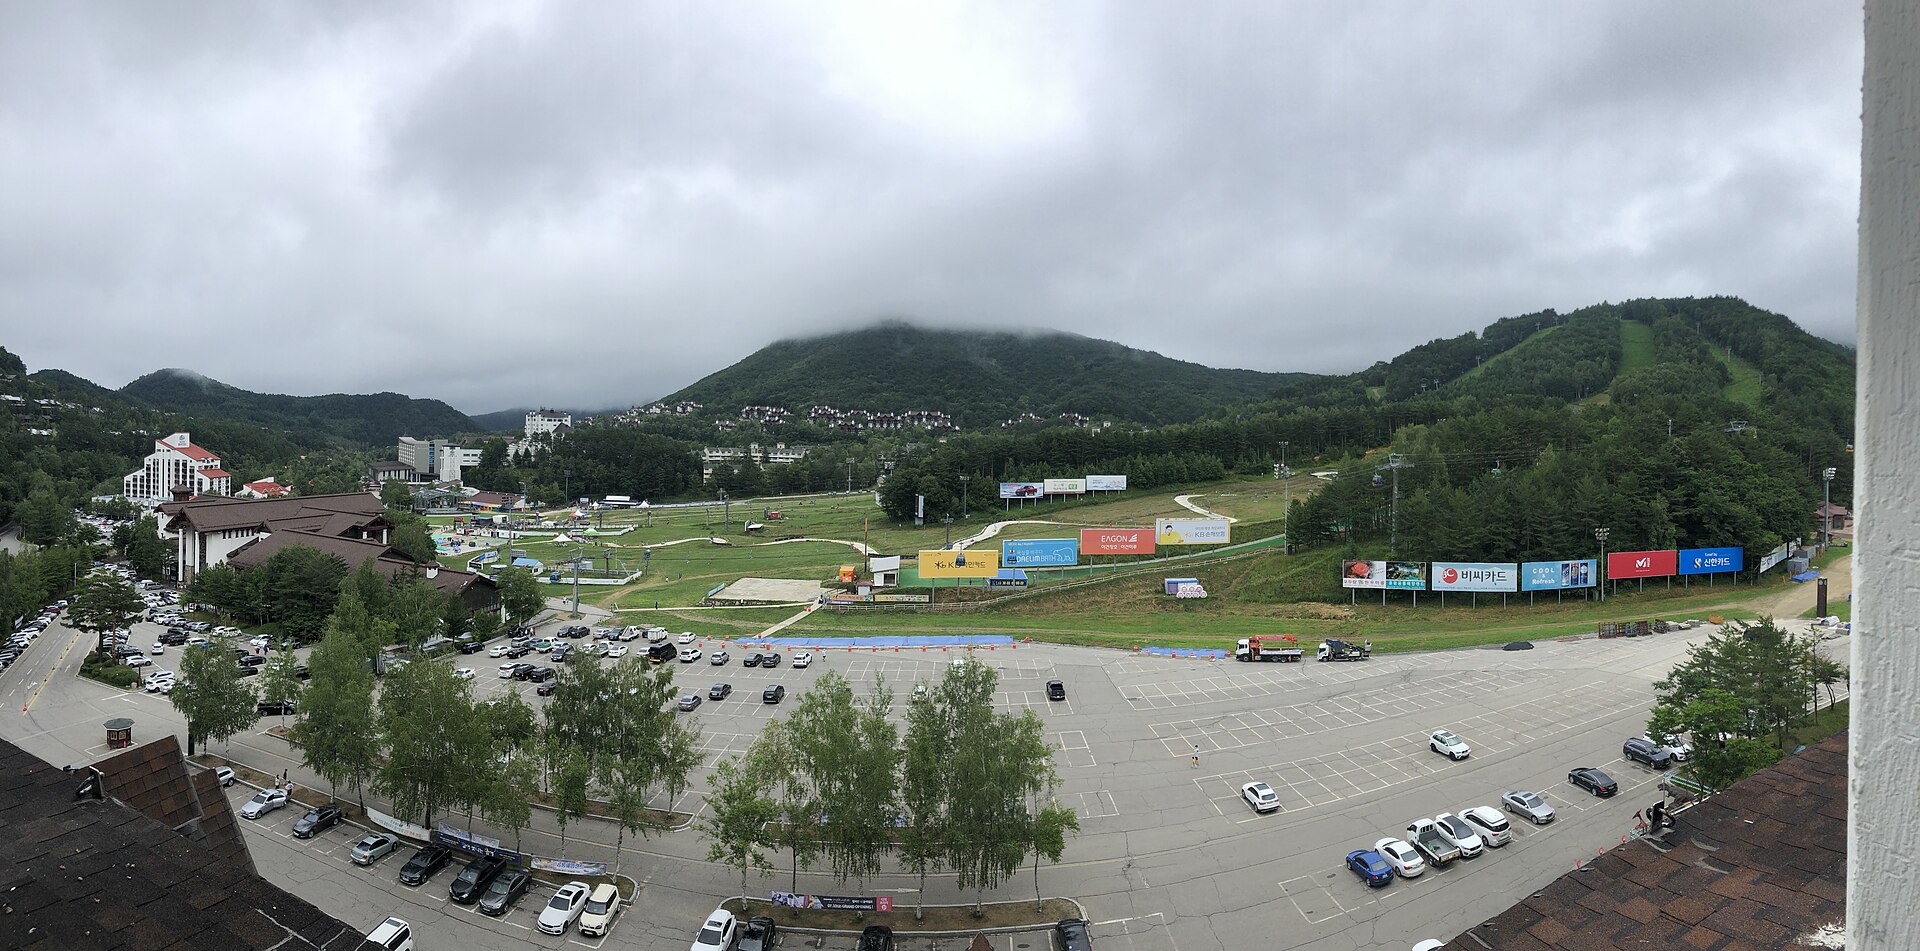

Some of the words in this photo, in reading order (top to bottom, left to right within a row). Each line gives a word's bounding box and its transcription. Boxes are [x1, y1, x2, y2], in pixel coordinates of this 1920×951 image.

[1101, 535, 1128, 543] EAGON
[1704, 557, 1731, 567] 신한카드
[1461, 570, 1507, 583] 비씨카드
